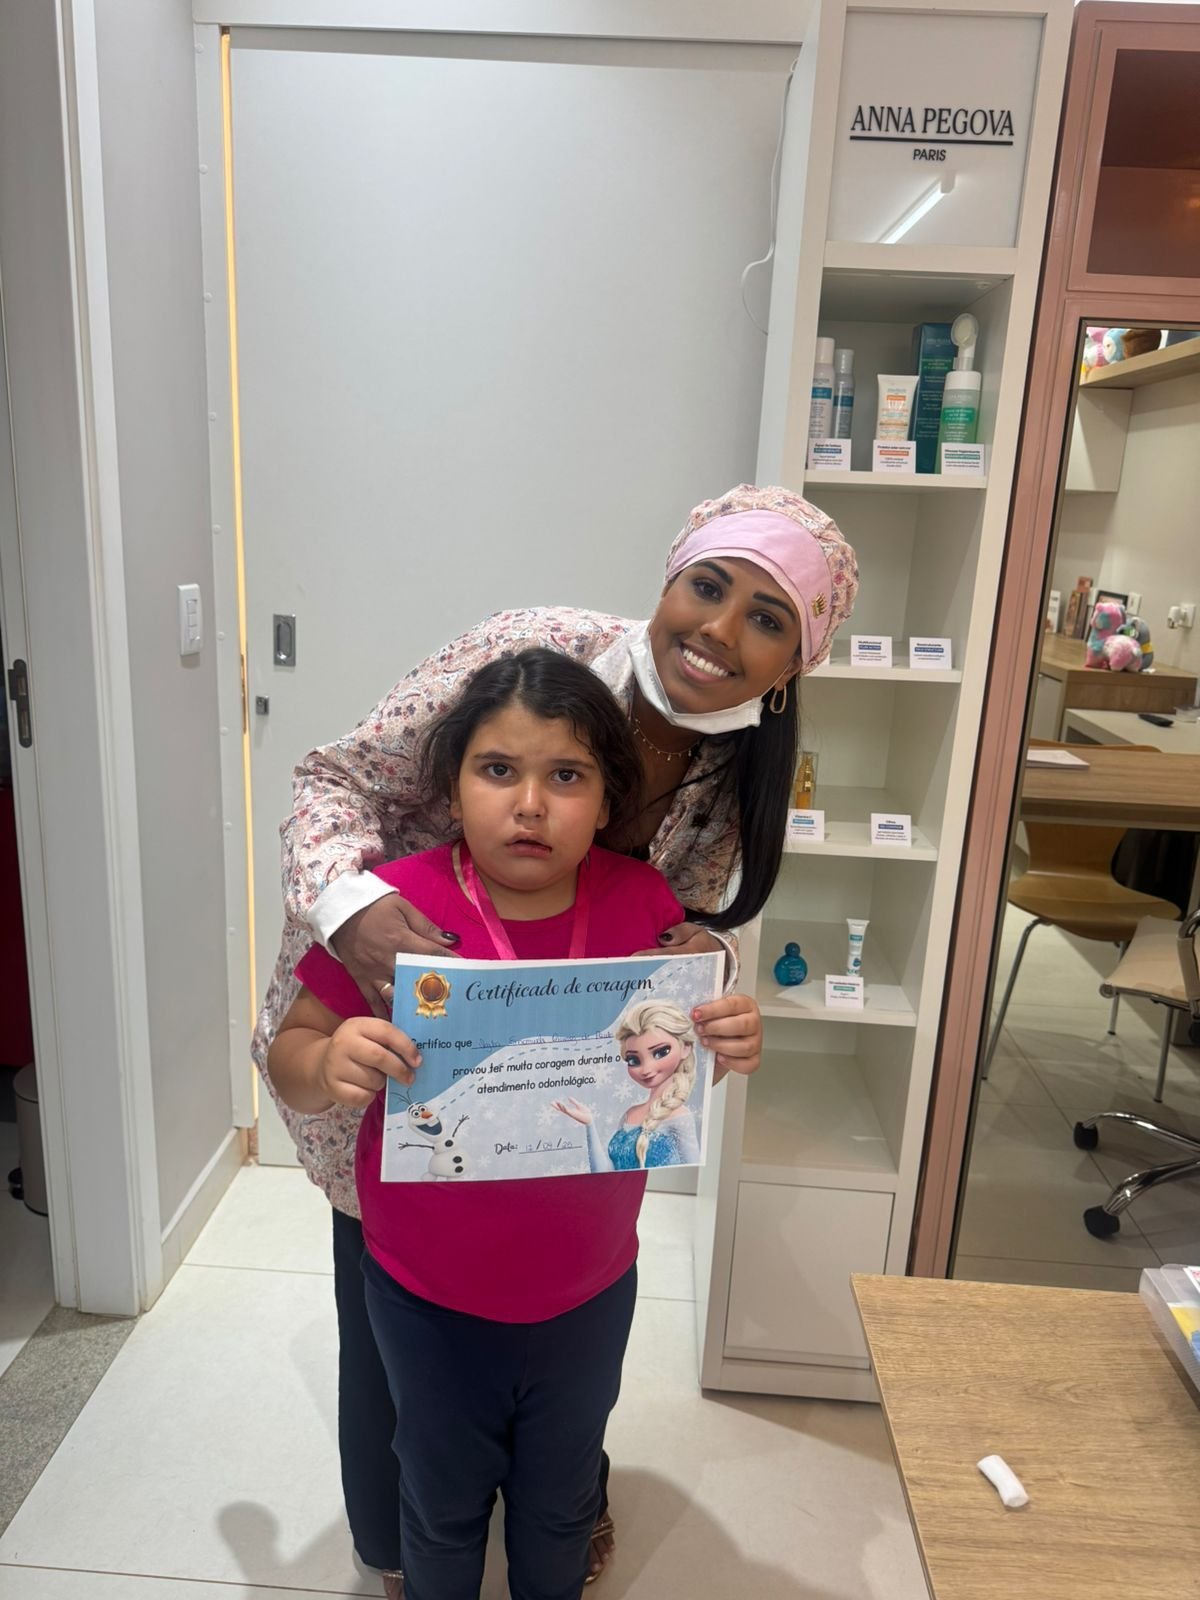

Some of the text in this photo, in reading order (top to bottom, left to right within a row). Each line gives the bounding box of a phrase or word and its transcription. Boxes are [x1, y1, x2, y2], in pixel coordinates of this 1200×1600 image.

[850, 105, 1015, 136] ANNA PEGOVA
[913, 149, 947, 161] PARIS
[465, 977, 653, 1007] Certificado de coragem
[454, 1039, 473, 1052] que
[452, 1053, 621, 1078] provou ter muita coragem durante o
[477, 1076, 596, 1095] atendimento odontológico.
[494, 1141, 518, 1155] Data:
